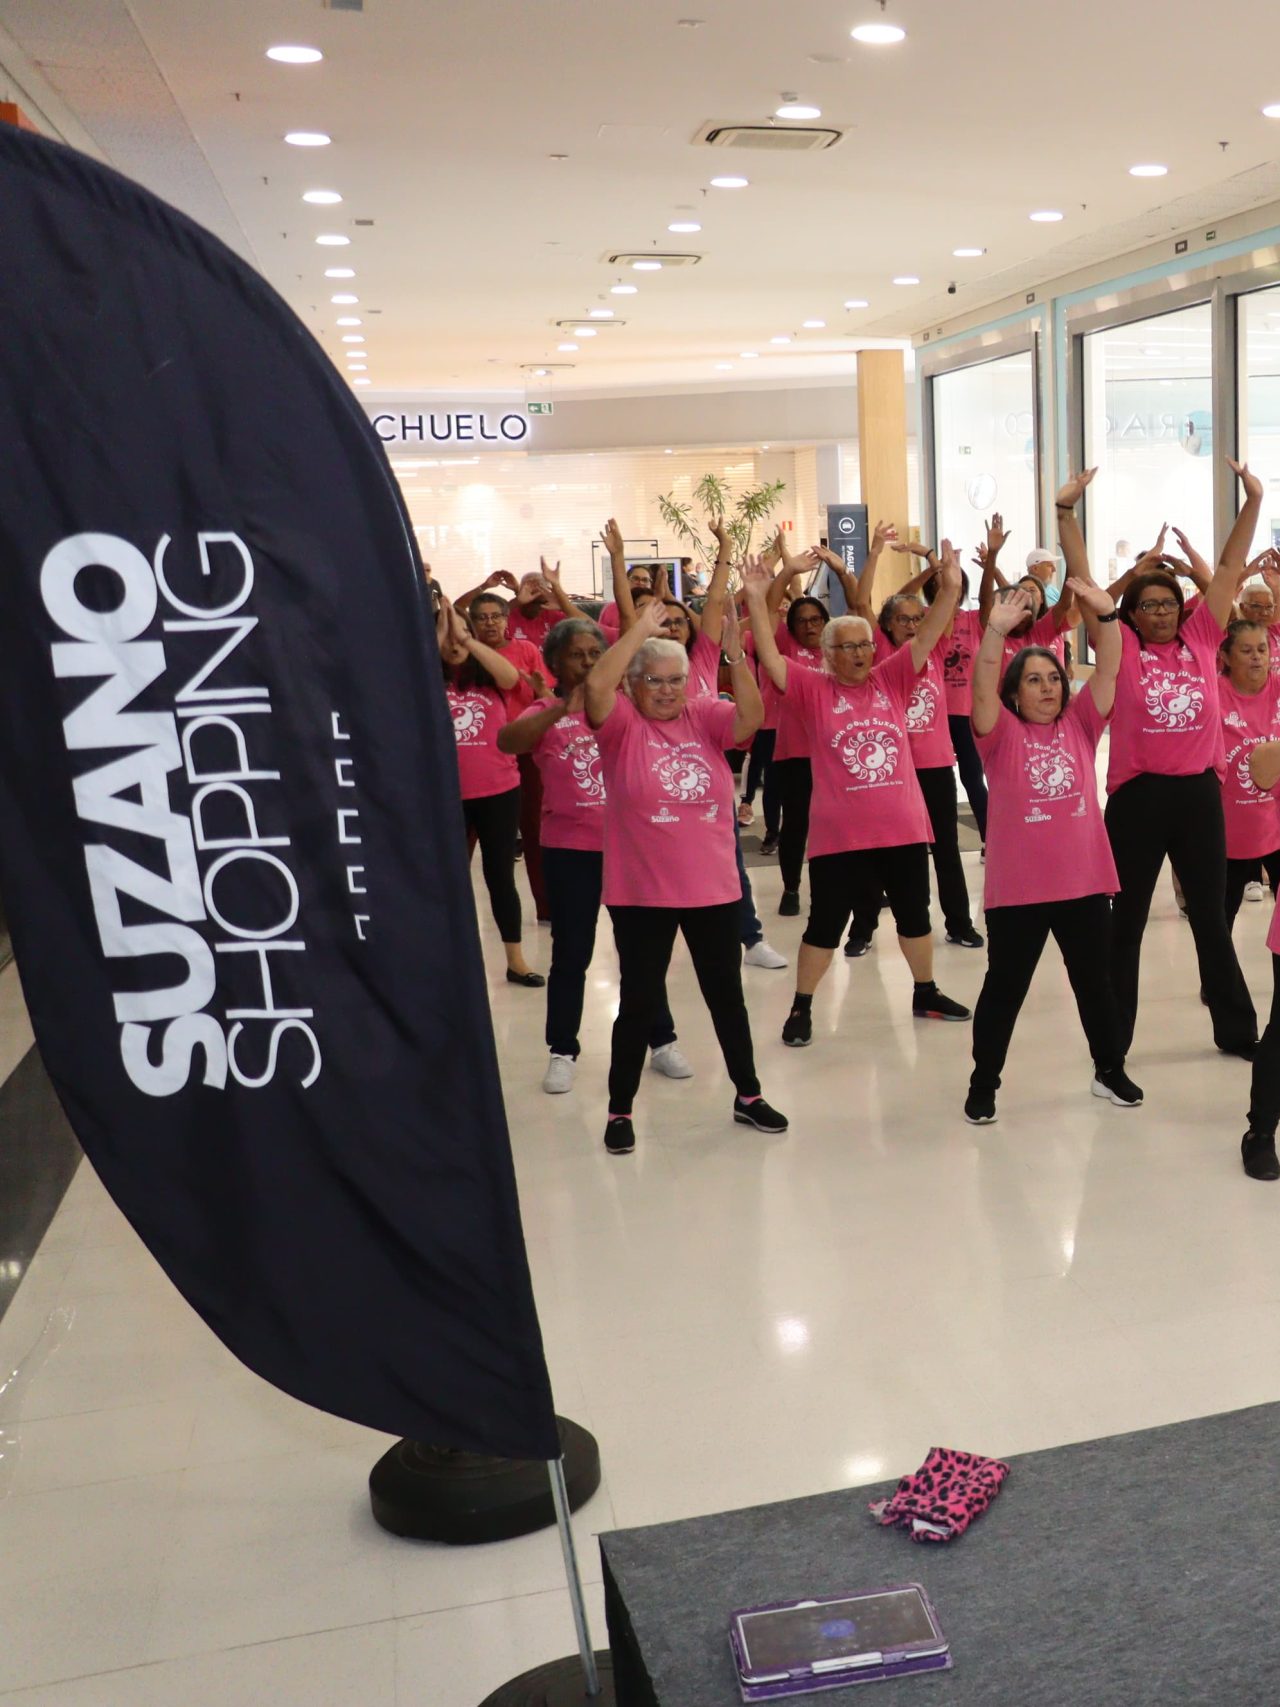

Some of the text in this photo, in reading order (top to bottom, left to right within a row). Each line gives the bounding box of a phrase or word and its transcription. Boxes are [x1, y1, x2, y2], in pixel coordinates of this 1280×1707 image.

[373, 414, 527, 441] CHUELO
[1152, 667, 1176, 680] Gng
[831, 730, 846, 748] Lian
[872, 717, 903, 738] Suzano
[1225, 745, 1242, 763] Lian
[39, 532, 228, 1097] SUZANO
[154, 531, 322, 1090] SHOPPING
